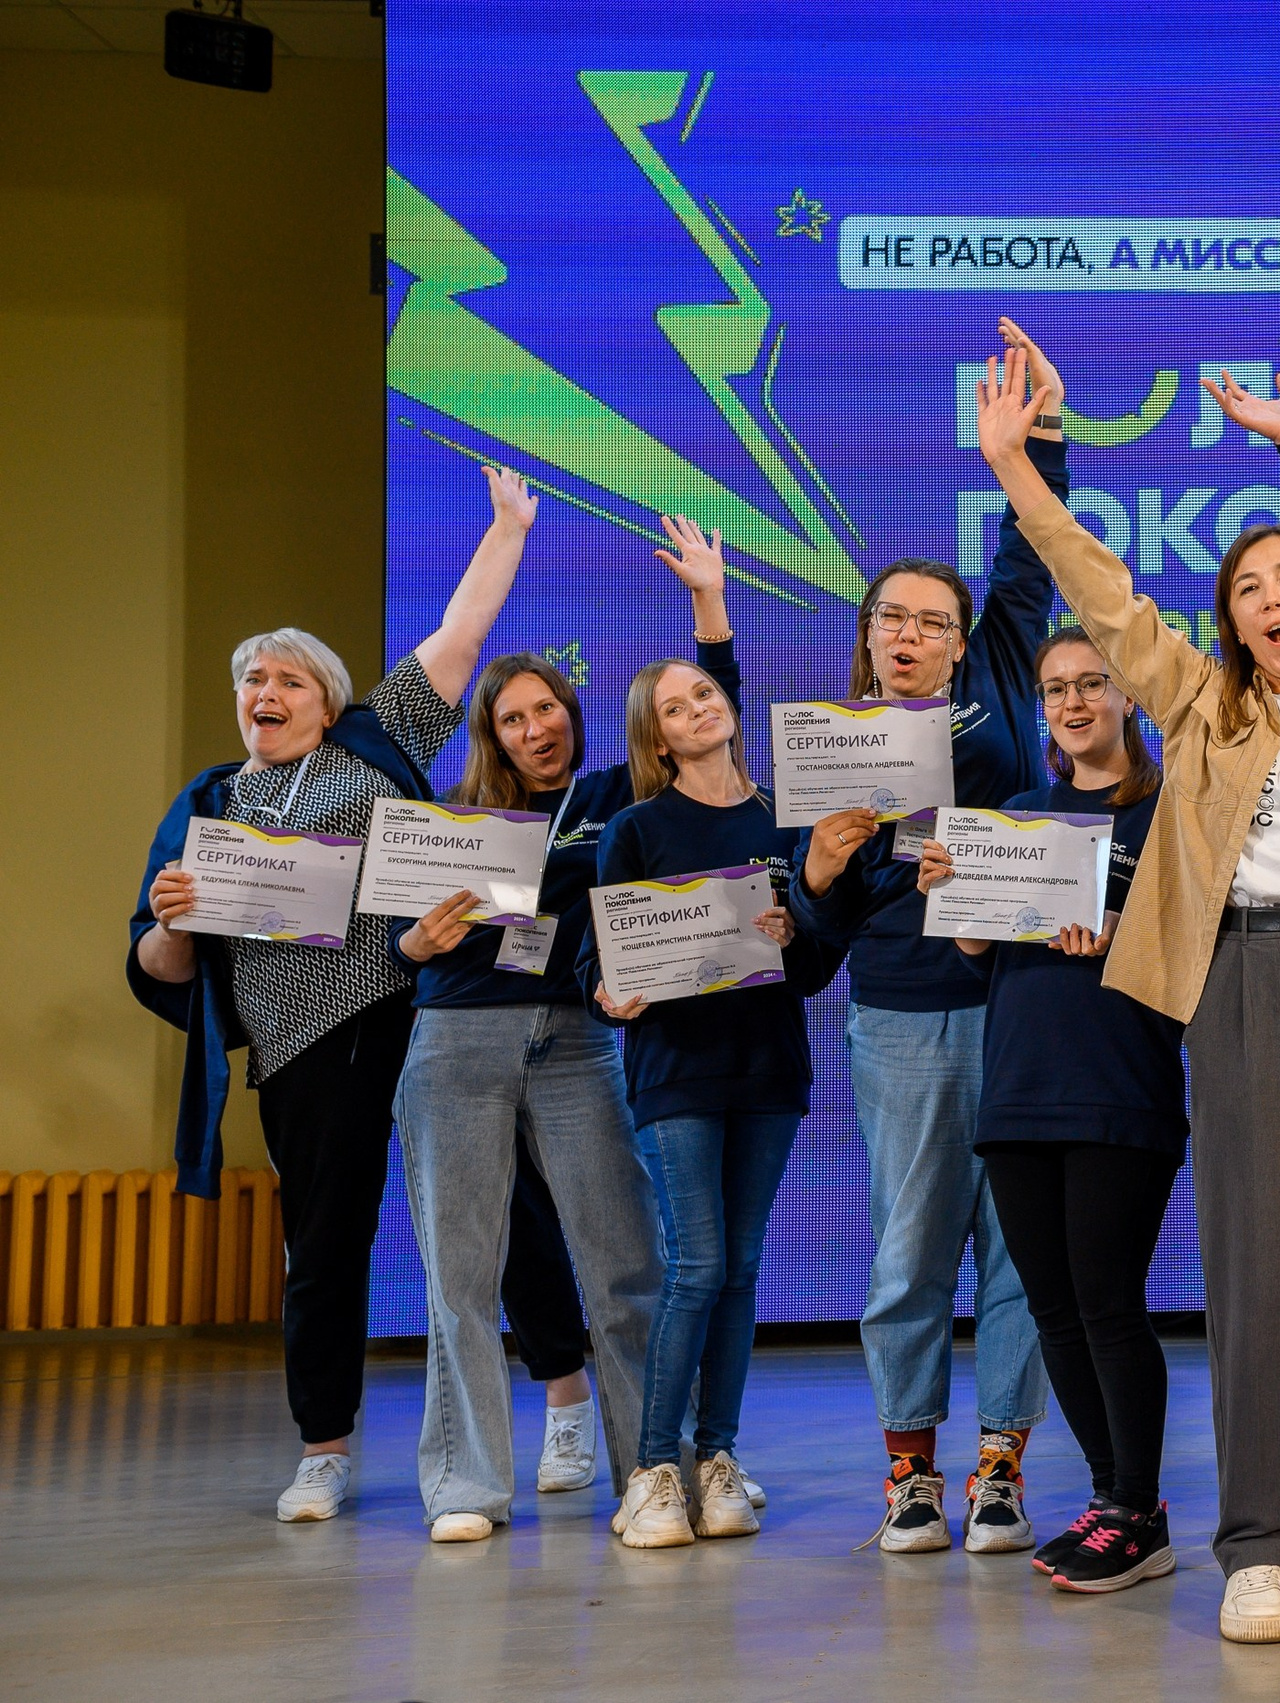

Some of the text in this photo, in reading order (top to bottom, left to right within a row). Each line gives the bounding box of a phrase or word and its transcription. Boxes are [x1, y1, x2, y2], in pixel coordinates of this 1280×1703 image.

[861, 236, 914, 267] НЕ
[929, 237, 1095, 275] РАБОТА,
[1109, 238, 1139, 269] А
[784, 718, 831, 726] ПОКОЛЕНИЯ
[786, 734, 888, 751] СЕРТИФИКАТ
[796, 761, 915, 772] ТОСТАНОВСКАЯ ОЛЬГА АНДРЕЕВНА
[384, 814, 430, 824] ПОКОЛЕНИЯ
[947, 824, 993, 833] ПОКОЛЕНИЯ
[199, 833, 245, 844] ПОКОЛЕНИЯ
[382, 831, 484, 851] СЕРТИФИКАТ
[946, 843, 1047, 861] СЕРТИФИКАТ
[197, 849, 297, 873] СЕРТИФИКАТ
[387, 856, 516, 874] БУСОРГИНА ИРИНА КОНСТАНТИНОВНА
[201, 875, 306, 894] БЕДУХИНА ЕЛЕНА НИКОЛАЕВНА
[952, 873, 1079, 886] МЕДВЕДЕВА МАРИЯ АЛЕКСАНДРОВНА
[605, 895, 652, 909] ПОКОЛЕНИЯ
[609, 904, 711, 932] СЕРТИФИКАТ
[621, 940, 655, 952] КОЩЕЕВА
[656, 935, 692, 946] КРИСТИНА
[693, 927, 741, 941] ГЕННАДЬЕВНА
